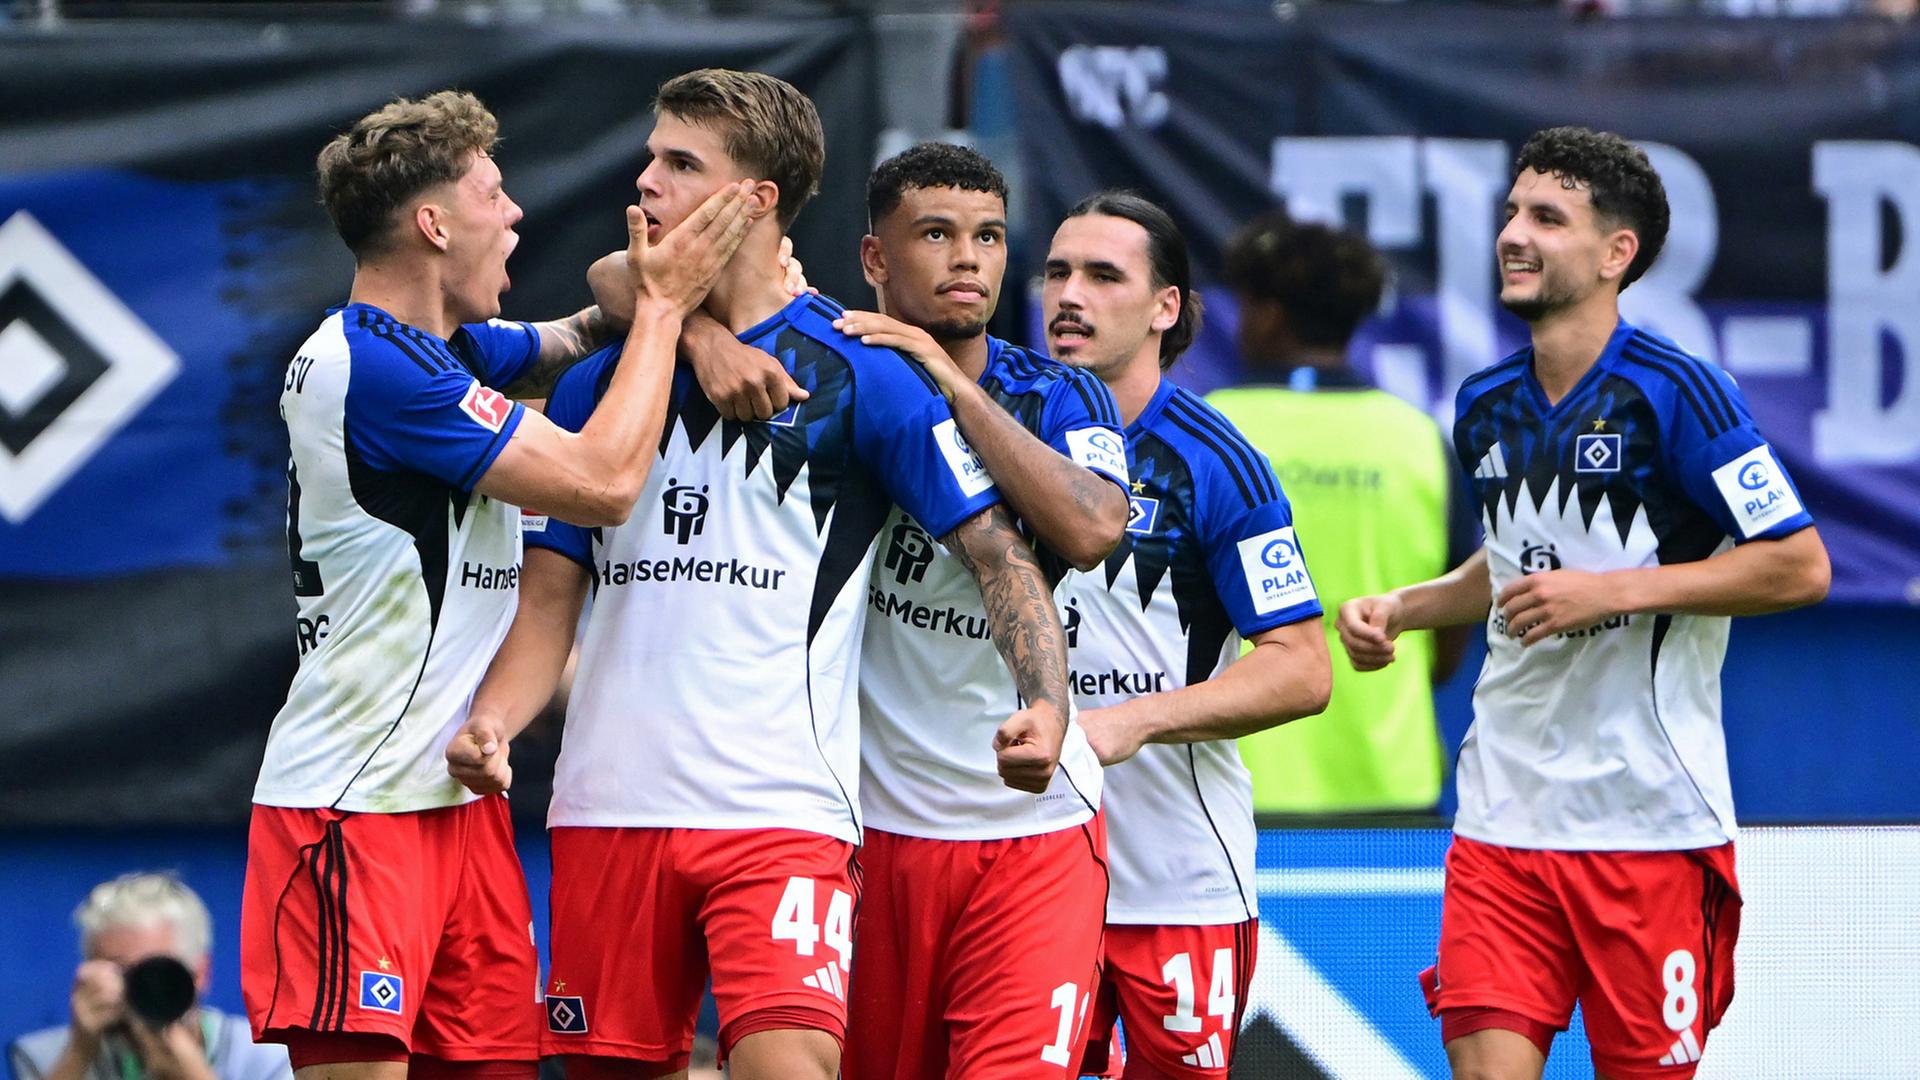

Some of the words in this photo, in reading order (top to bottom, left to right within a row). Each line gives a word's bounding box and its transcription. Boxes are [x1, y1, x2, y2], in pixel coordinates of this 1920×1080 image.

[461, 561, 522, 591] Hanse
[771, 876, 853, 971] 44
[1162, 948, 1235, 1033] 14
[1662, 949, 1698, 1032] 8
